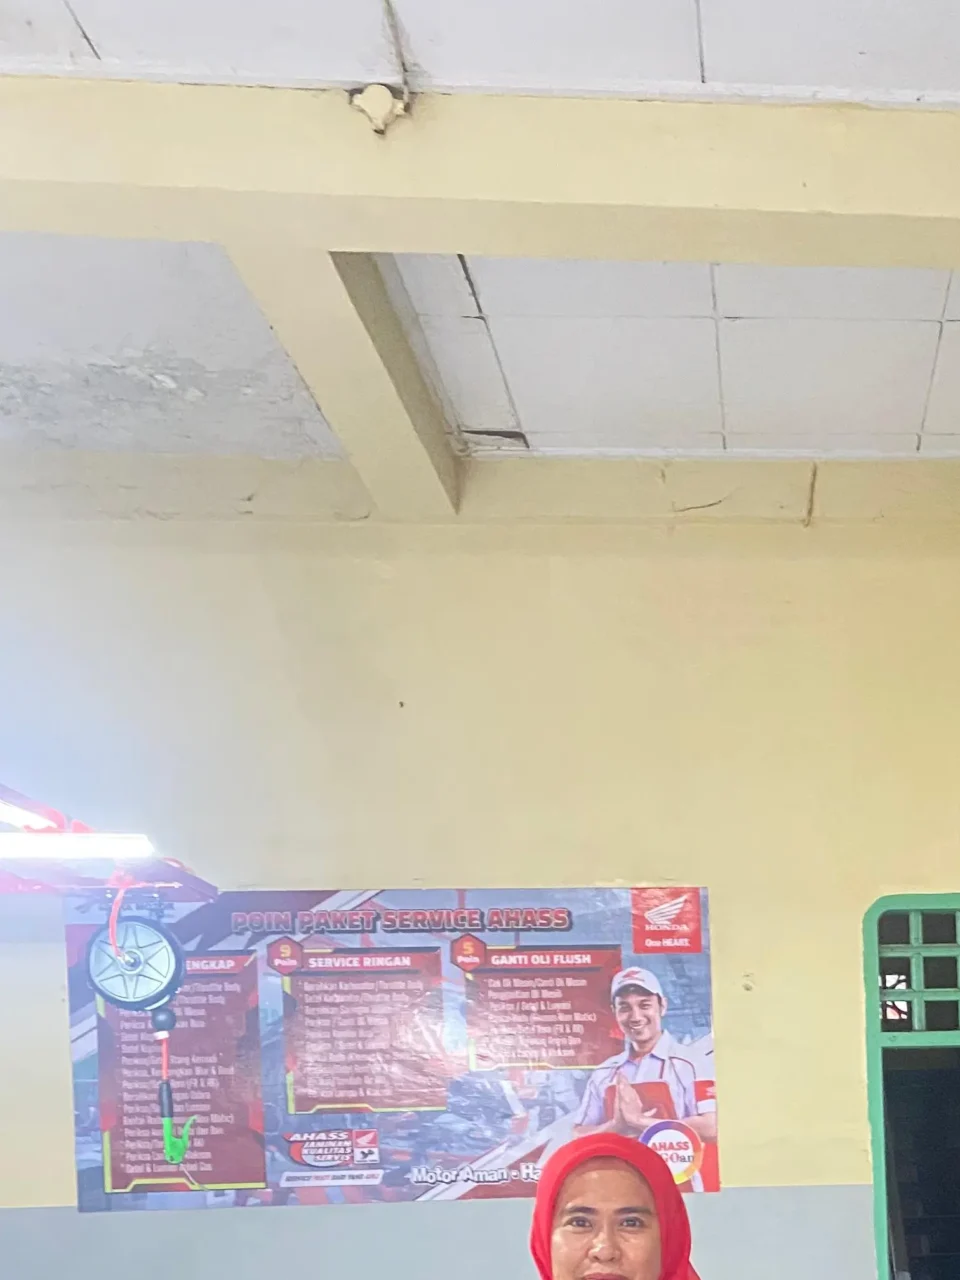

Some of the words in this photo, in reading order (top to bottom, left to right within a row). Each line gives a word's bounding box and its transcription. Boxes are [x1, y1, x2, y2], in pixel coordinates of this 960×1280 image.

[231, 911, 293, 933] POIN
[297, 910, 377, 933] PAKET
[382, 908, 483, 931] SERVICE
[487, 907, 571, 930] AHASS
[279, 944, 292, 958] 9
[463, 941, 475, 955] 5
[186, 959, 236, 970] ENGKAP
[273, 957, 298, 967] Poin
[308, 956, 361, 968] SERVICE
[363, 955, 411, 967] RINGAN
[456, 954, 480, 965] Poin
[491, 954, 528, 966] GANTI
[530, 954, 551, 965] OLI
[553, 953, 592, 964] FLUSH
[290, 1131, 350, 1141] AHASS
[303, 1140, 352, 1148] JAMINAN
[650, 1142, 690, 1151] AHASS
[302, 1147, 353, 1155] KUALITAS
[411, 1165, 458, 1184] Motor
[458, 1164, 509, 1183] Aman
[520, 1162, 543, 1182] Ha
